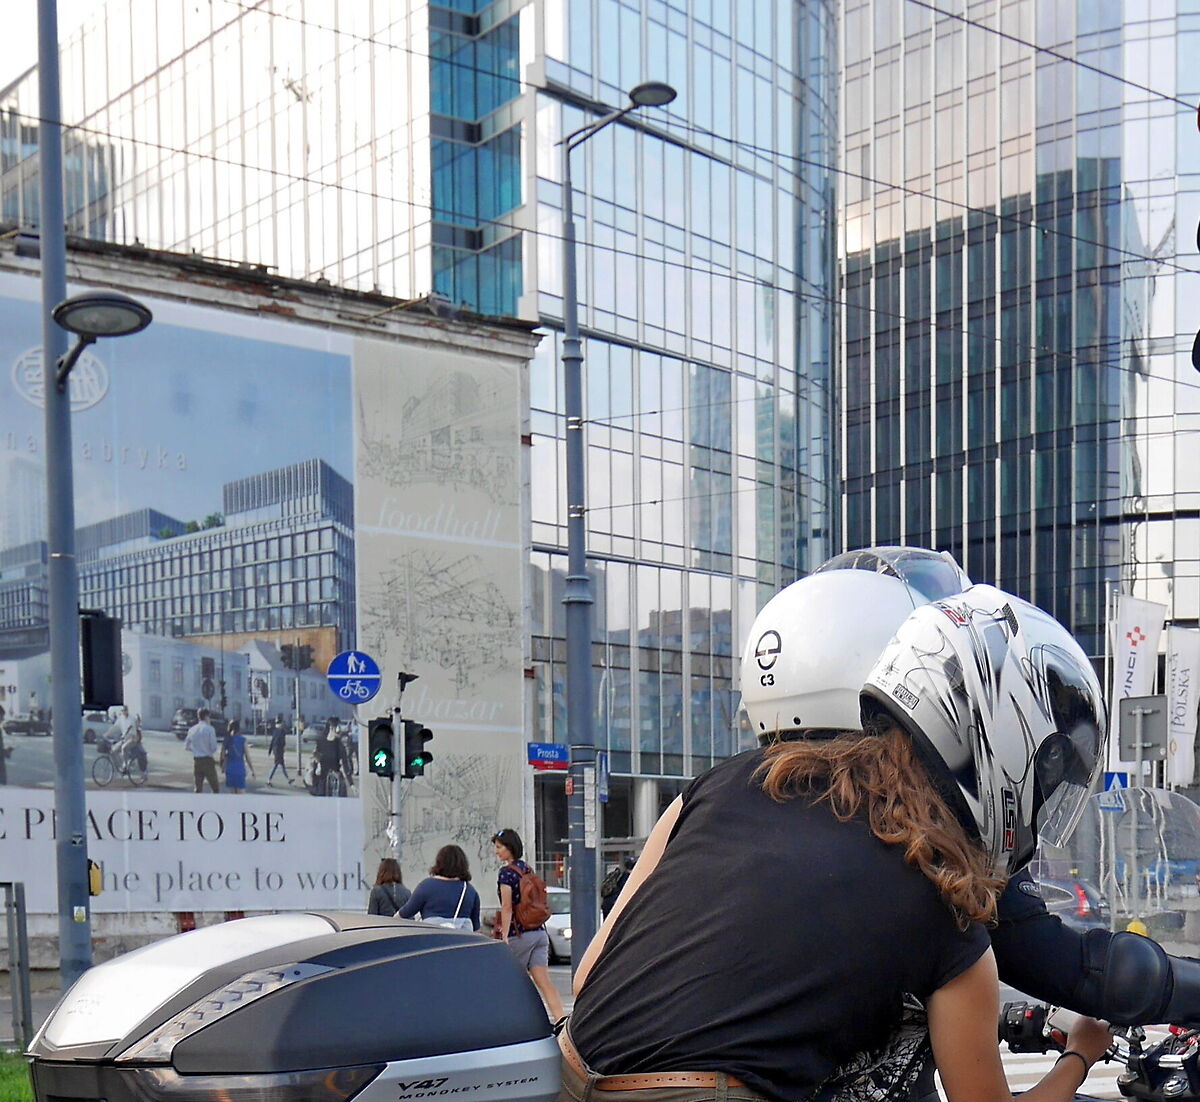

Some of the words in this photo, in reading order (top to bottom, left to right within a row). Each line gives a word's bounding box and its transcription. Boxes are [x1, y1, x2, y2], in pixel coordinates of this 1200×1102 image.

[81, 441, 189, 472] abryka
[371, 497, 501, 538] foodhall
[1173, 667, 1191, 728] POLSKA
[537, 748, 560, 759] Prosta
[22, 807, 160, 842] PACE
[169, 810, 225, 843] TO
[238, 811, 287, 843] BE
[1003, 789, 1015, 849] LS2
[100, 860, 140, 893] he
[155, 861, 242, 902] place
[255, 867, 284, 892] to
[297, 862, 372, 892] work
[397, 1077, 449, 1091] V47
[399, 1085, 481, 1100] MONOKEY
[487, 1076, 539, 1089] SYSTEM
